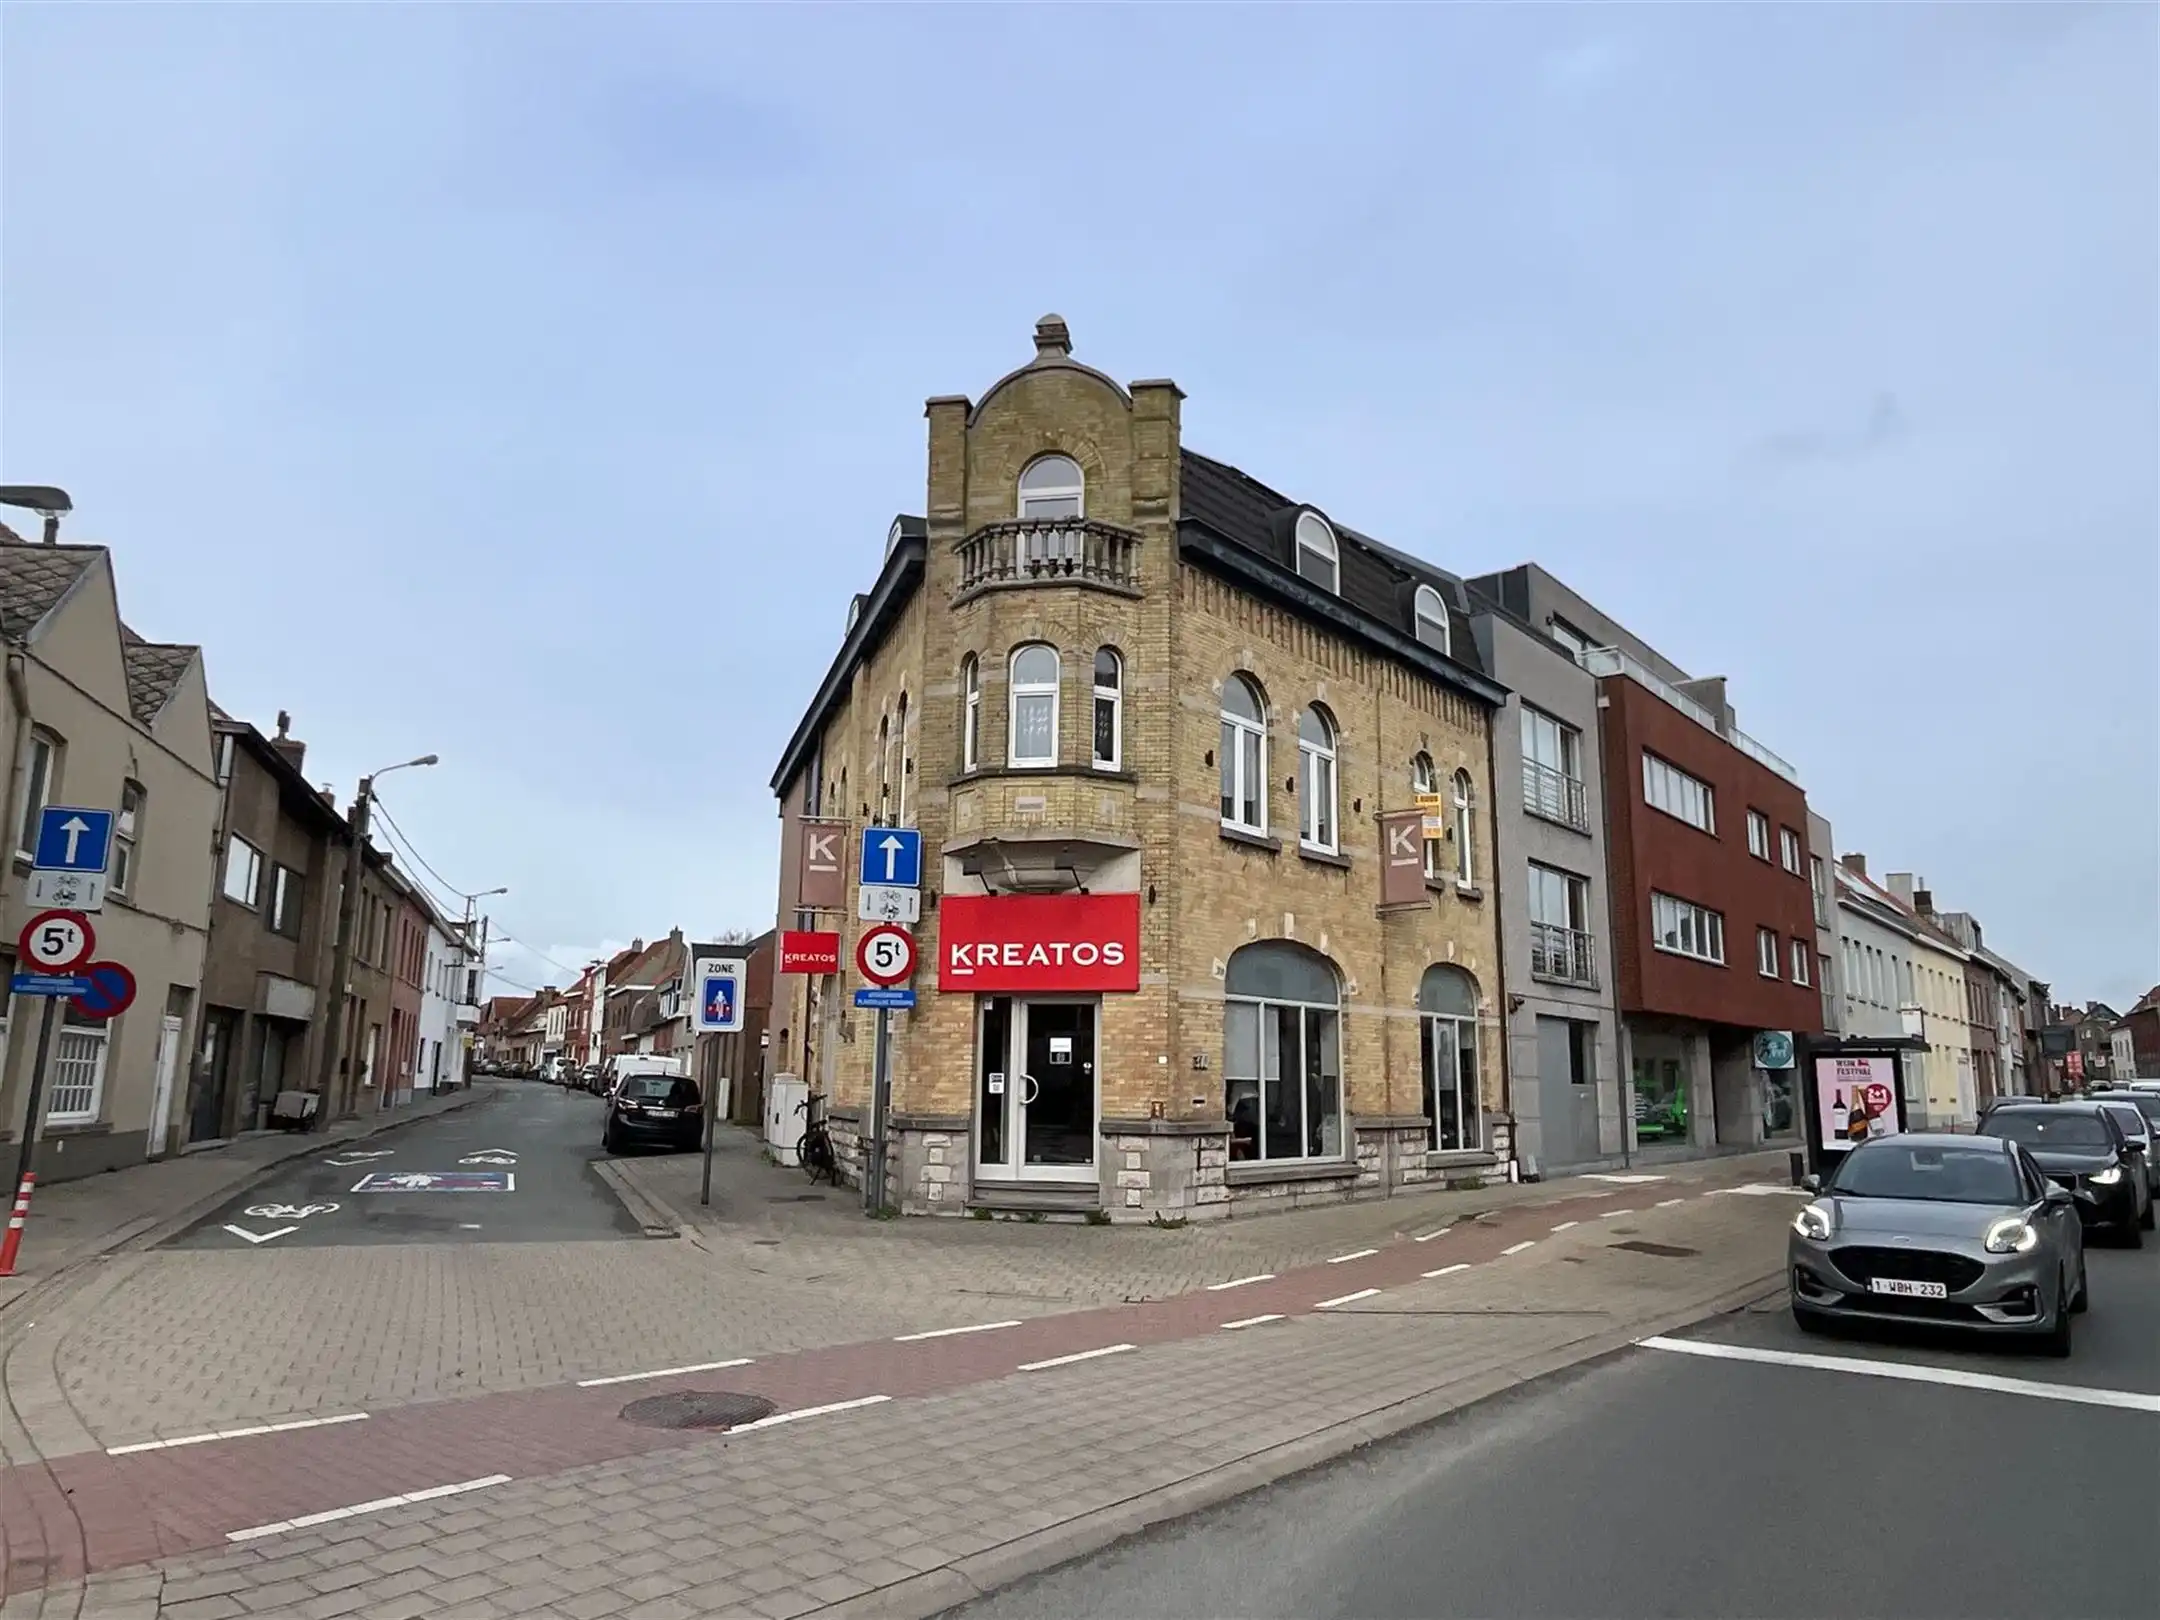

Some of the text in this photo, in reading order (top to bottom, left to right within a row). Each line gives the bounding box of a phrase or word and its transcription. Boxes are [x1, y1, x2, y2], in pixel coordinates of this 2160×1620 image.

[808, 834, 836, 862] K
[1389, 824, 1417, 856] K
[41, 927, 75, 956] 5t
[874, 941, 901, 968] 5t
[708, 963, 735, 974] ZONE
[784, 952, 836, 964] KREATOS
[951, 942, 1125, 975] KREATOS
[1836, 1067, 1871, 1076] FESTIVAL
